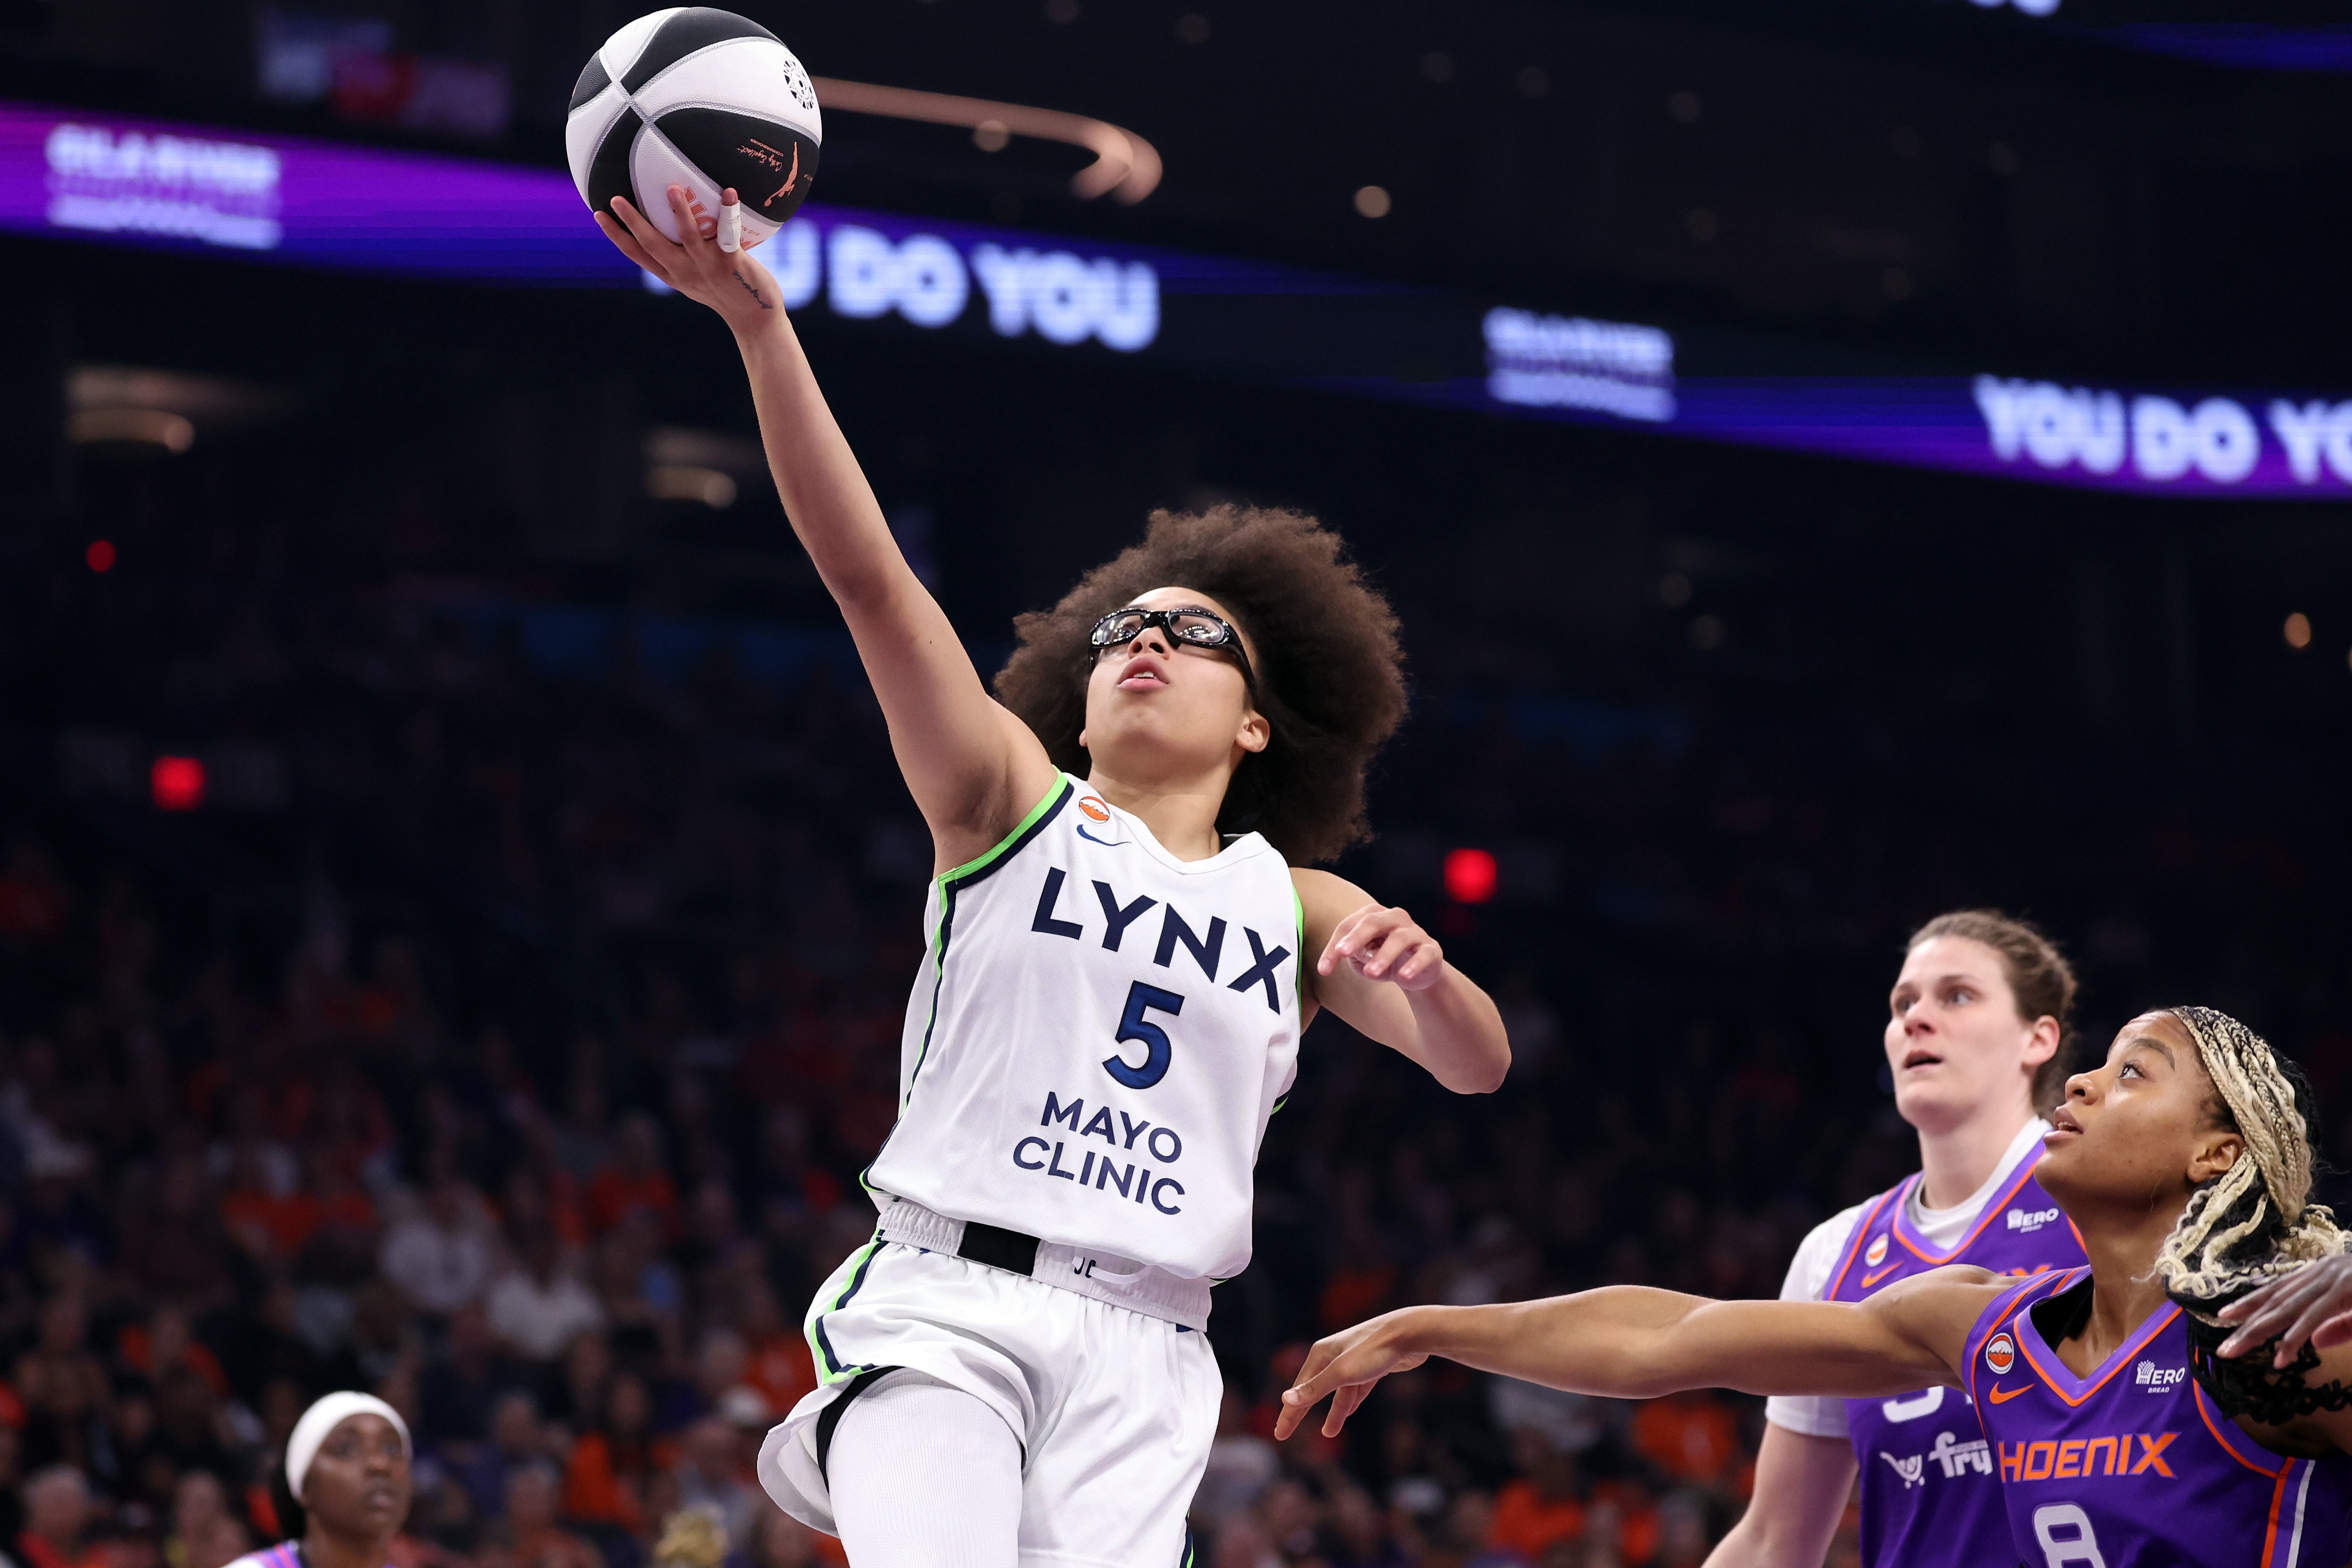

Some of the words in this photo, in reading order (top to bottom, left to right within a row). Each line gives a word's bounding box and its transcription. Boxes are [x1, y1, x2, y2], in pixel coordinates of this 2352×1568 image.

[830, 223, 969, 328] DO
[973, 242, 1161, 352] YOU
[1972, 374, 2126, 476] YOU
[2132, 394, 2260, 484] DO
[1031, 867, 1291, 1015] LYNX
[1102, 980, 1185, 1089] 5
[1041, 1092, 1182, 1163] MAYO
[1013, 1136, 1185, 1215] CLINIC
[2135, 1359, 2185, 1385] HERO
[1997, 1432, 2182, 1483] HOENIX
[2032, 1501, 2107, 1568] 8
